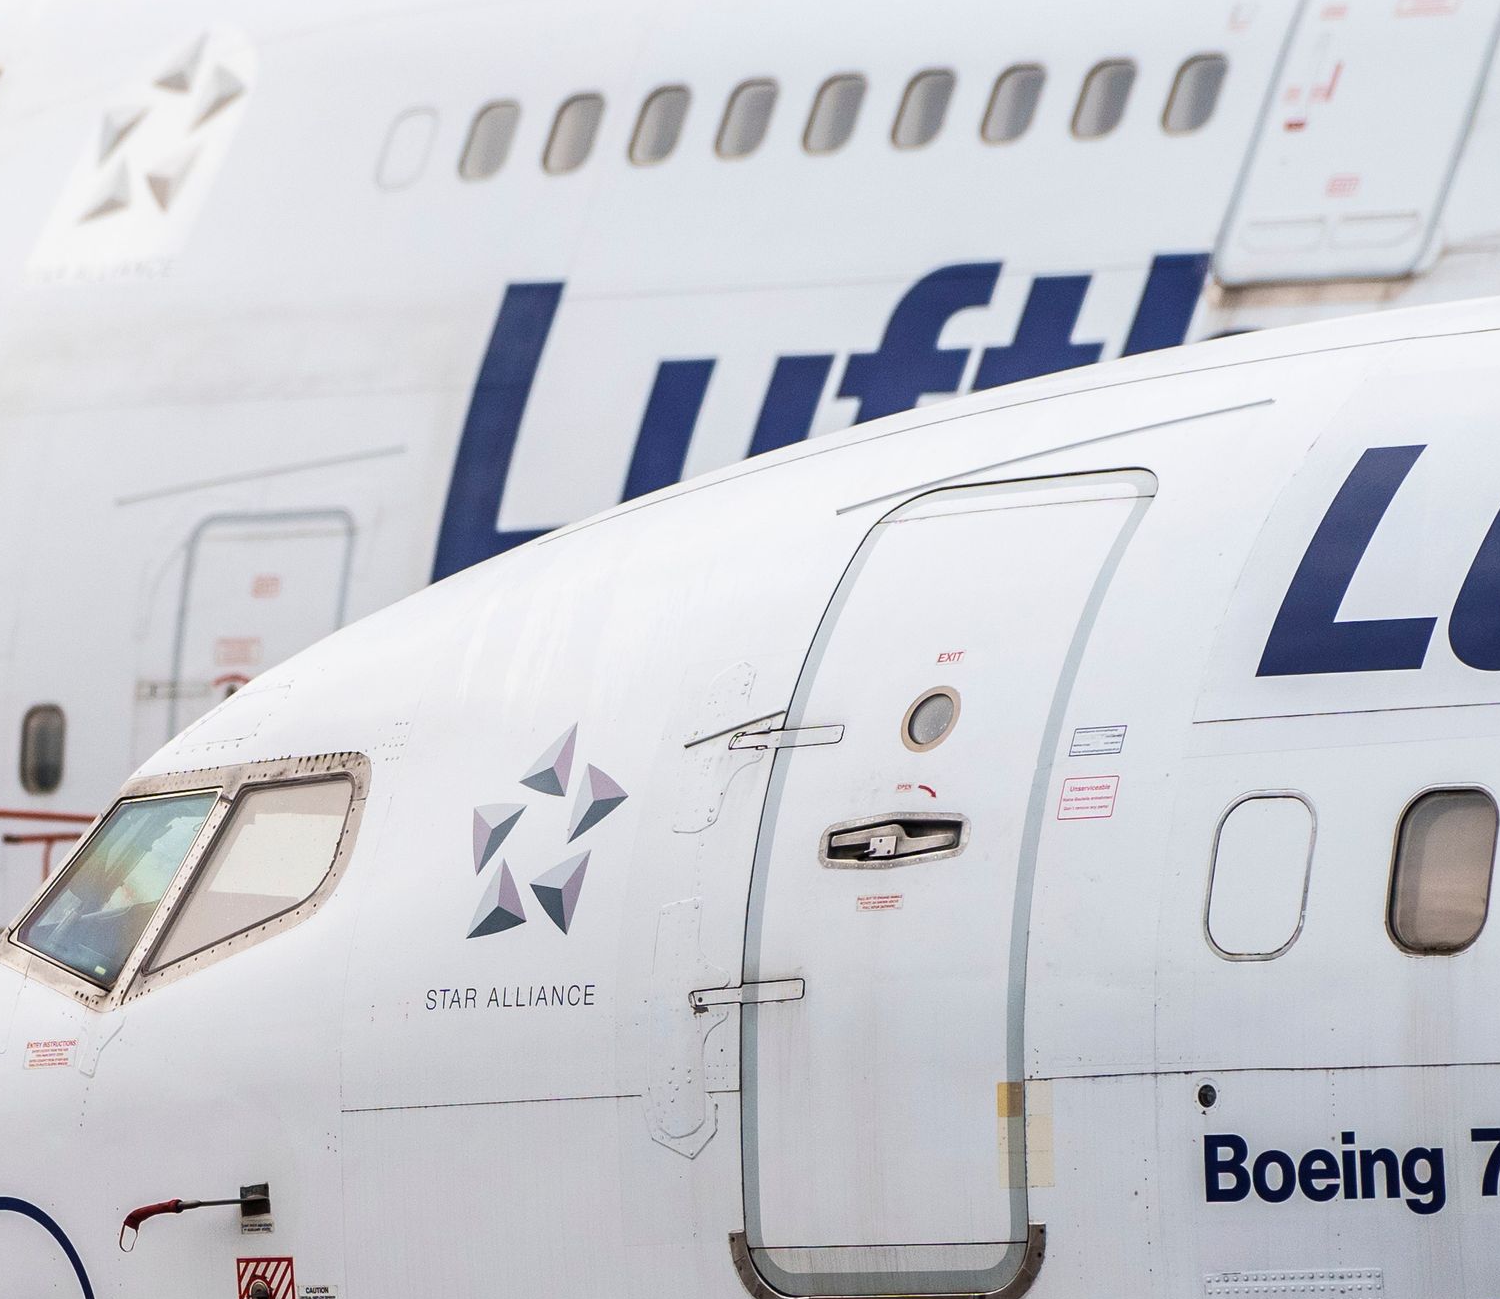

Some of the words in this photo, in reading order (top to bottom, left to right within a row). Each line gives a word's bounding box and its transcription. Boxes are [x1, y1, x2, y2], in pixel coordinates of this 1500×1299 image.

[937, 651, 964, 663] EXIT
[425, 988, 477, 1011] STAR
[487, 984, 596, 1008] ALLIANCE
[1203, 1132, 1446, 1215] Boeing
